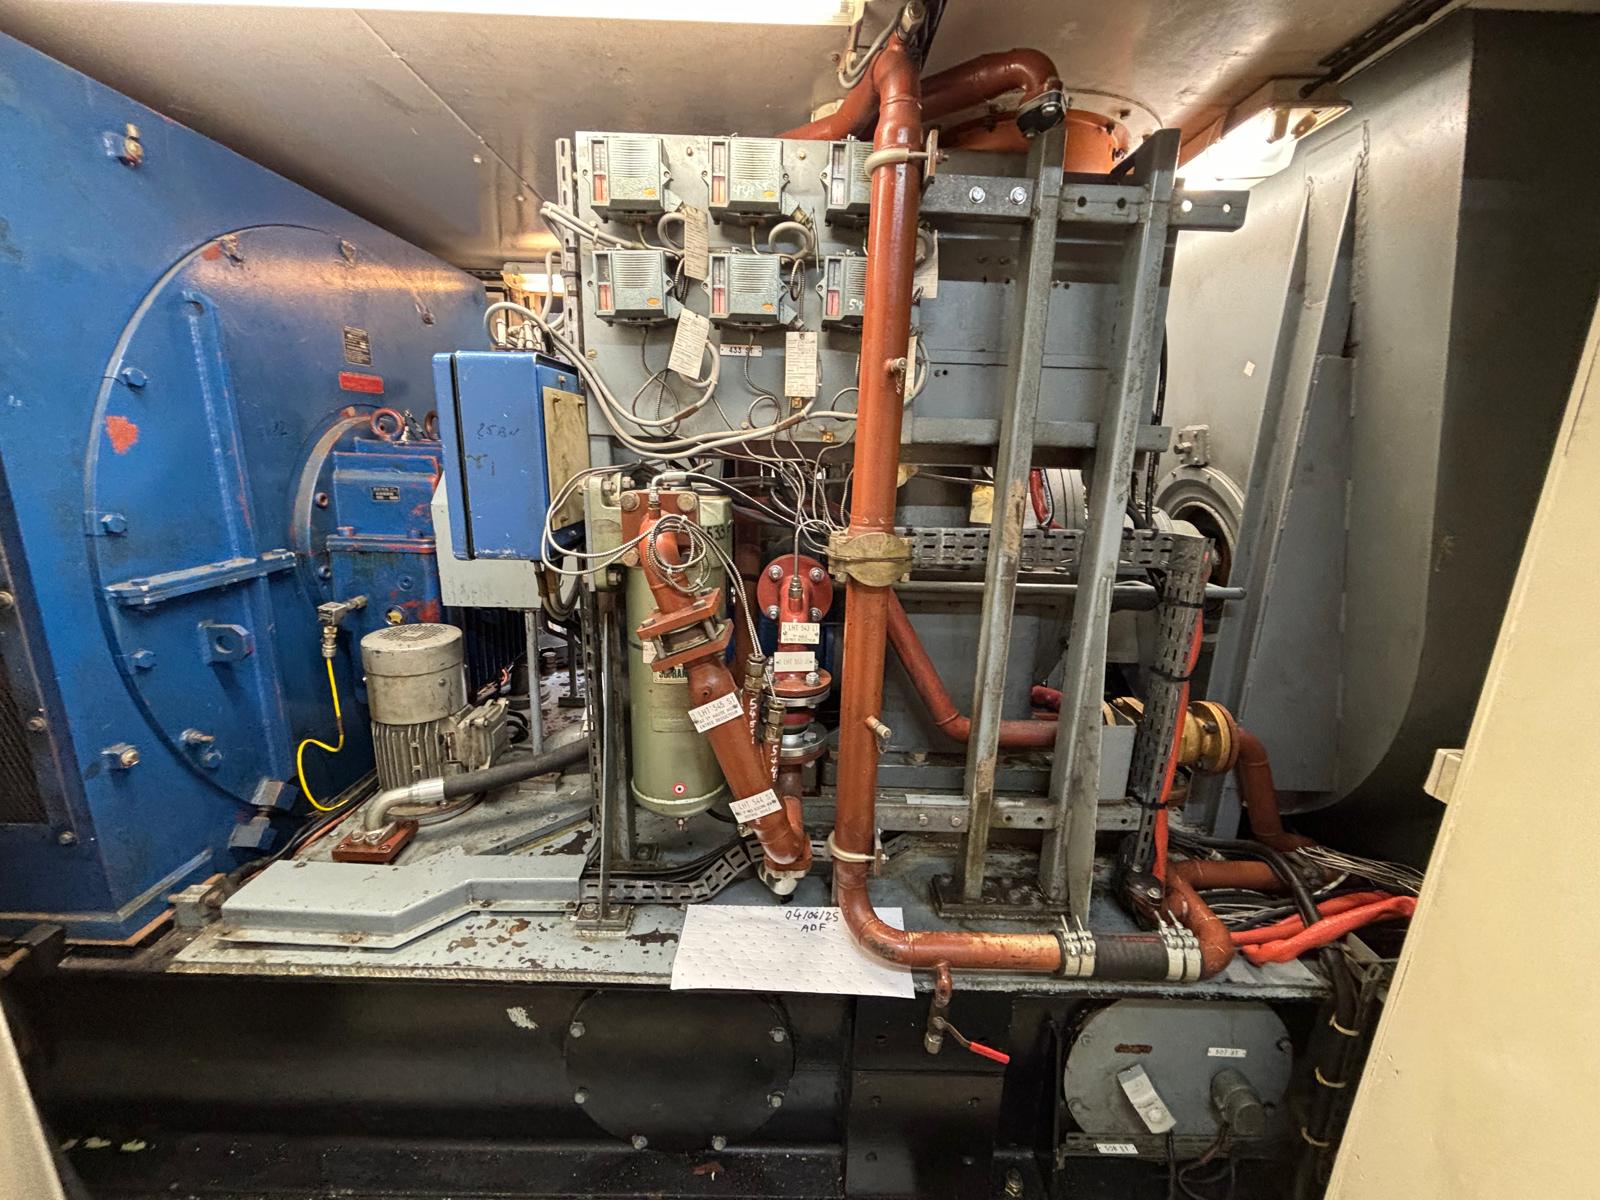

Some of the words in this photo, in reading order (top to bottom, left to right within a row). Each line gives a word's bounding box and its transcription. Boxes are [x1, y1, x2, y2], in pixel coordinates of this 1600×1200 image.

[729, 346, 742, 354] 433
[697, 707, 710, 717] LHT
[785, 908, 839, 922] 04/06/25
[800, 922, 827, 933] ADF
